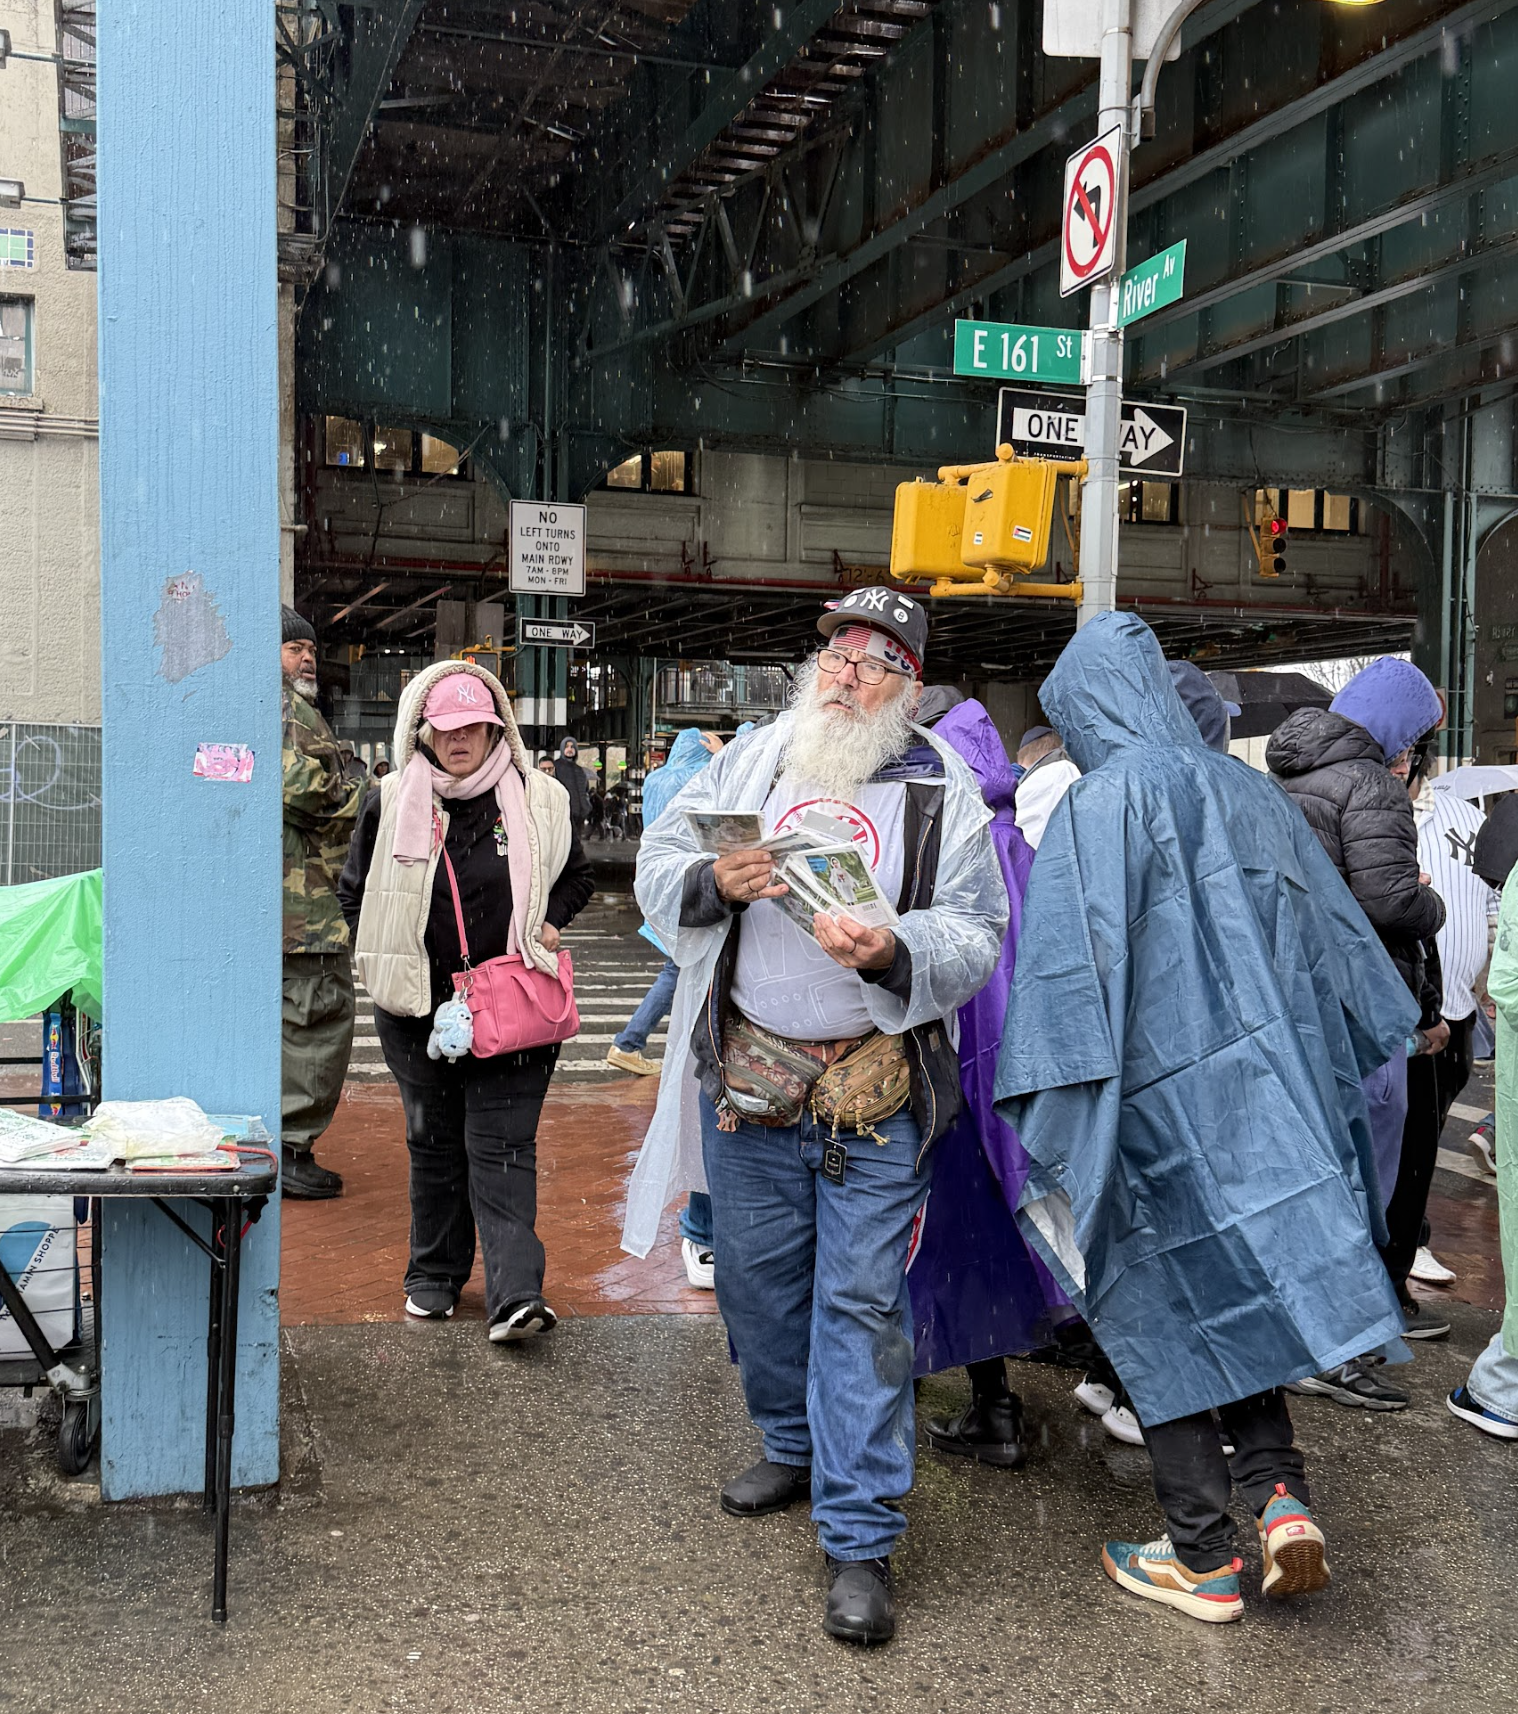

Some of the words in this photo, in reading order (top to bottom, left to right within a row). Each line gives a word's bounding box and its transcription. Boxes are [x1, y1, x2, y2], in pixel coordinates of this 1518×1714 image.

[1122, 275, 1159, 319] River
[1162, 254, 1176, 280] Av
[973, 329, 988, 369] E
[1001, 332, 1039, 373] 161
[1056, 335, 1073, 359] St
[1028, 413, 1079, 442] ONE
[1120, 425, 1156, 451] AY
[539, 511, 558, 524] NO
[520, 527, 542, 538] LEFT
[546, 528, 576, 540] TURNS
[535, 541, 560, 552] ONTO
[521, 553, 545, 565] MAIN
[548, 555, 574, 566] RDWY
[526, 566, 544, 574] 7AM
[551, 566, 569, 576] 8PM
[527, 575, 546, 585] MON
[554, 577, 567, 586] FRI
[860, 589, 889, 612] NY
[531, 626, 553, 638] ONE
[561, 629, 584, 640] WAY
[457, 683, 477, 704] NY
[18, 1265, 37, 1294] TAMIN
[34, 1225, 60, 1264] SHOPPE
